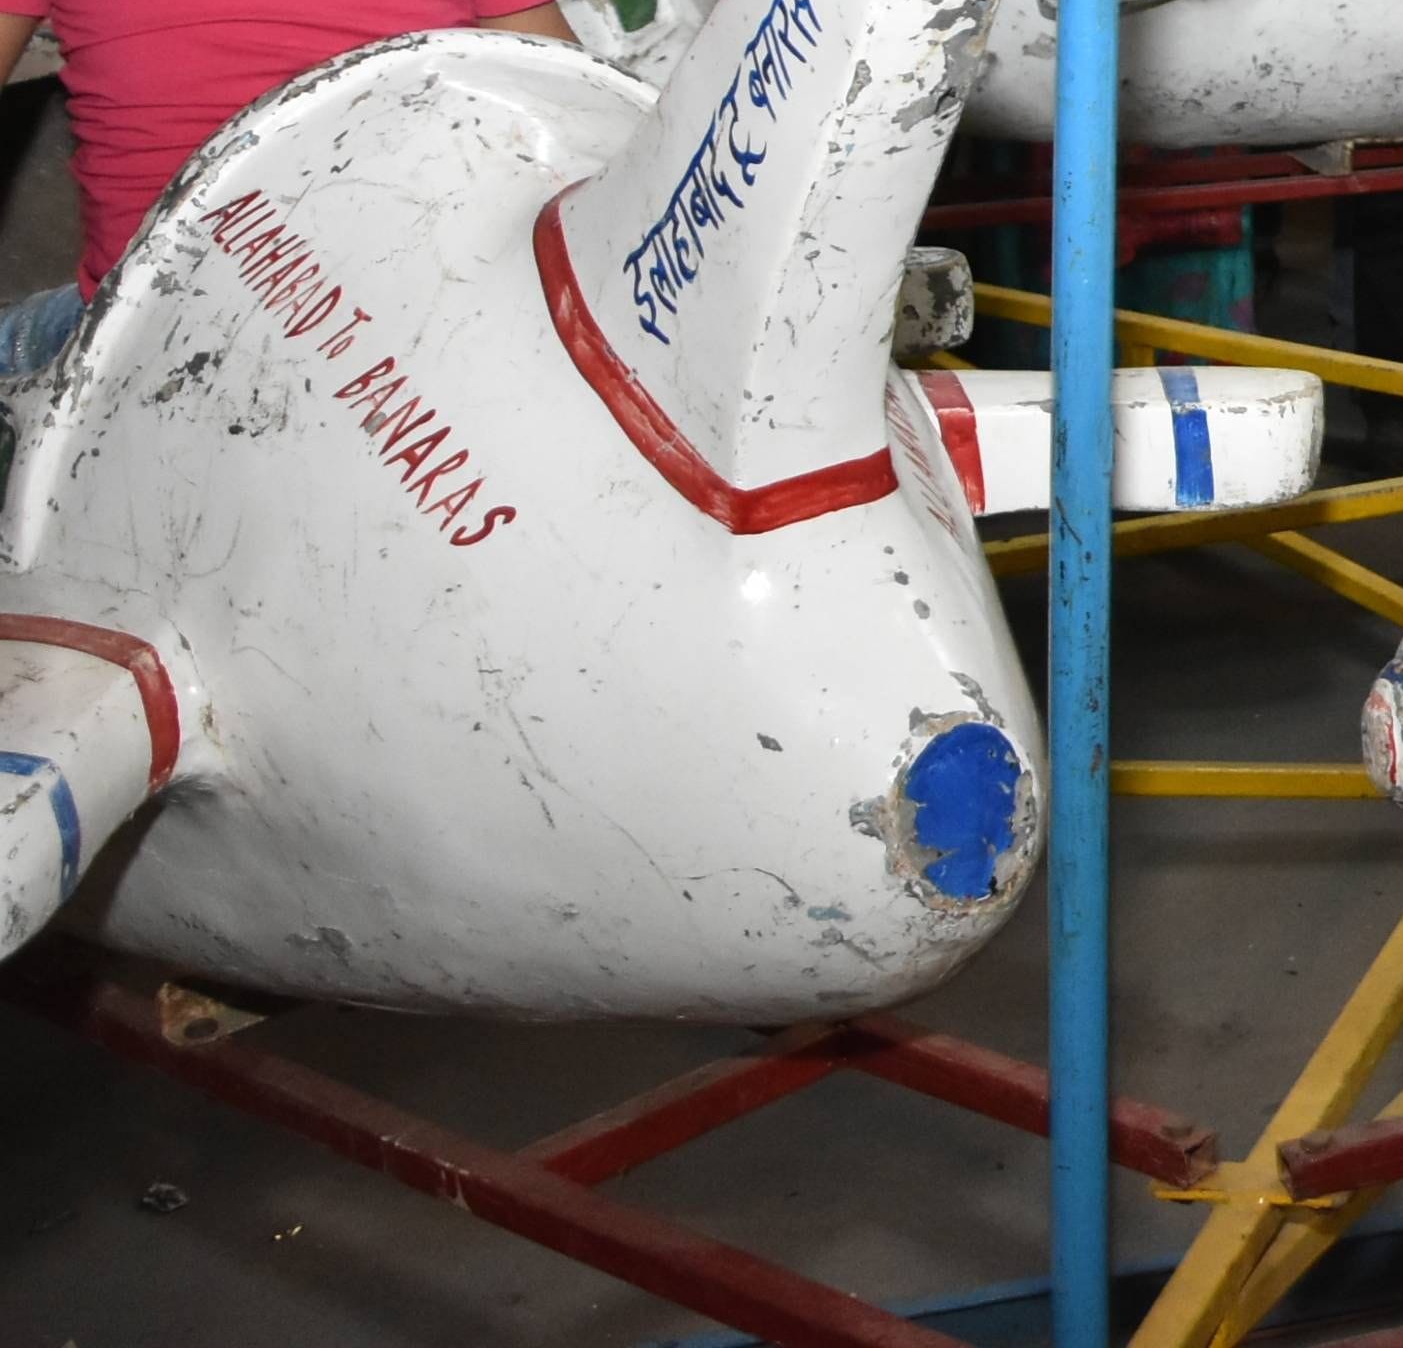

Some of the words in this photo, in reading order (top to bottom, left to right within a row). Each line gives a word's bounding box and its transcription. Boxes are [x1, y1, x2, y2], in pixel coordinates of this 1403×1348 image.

[623, 108, 744, 345] इलाहाबाद
[718, 63, 768, 187] टू
[197, 189, 342, 339] ALLAHABAD
[332, 355, 517, 547] BANARAS
